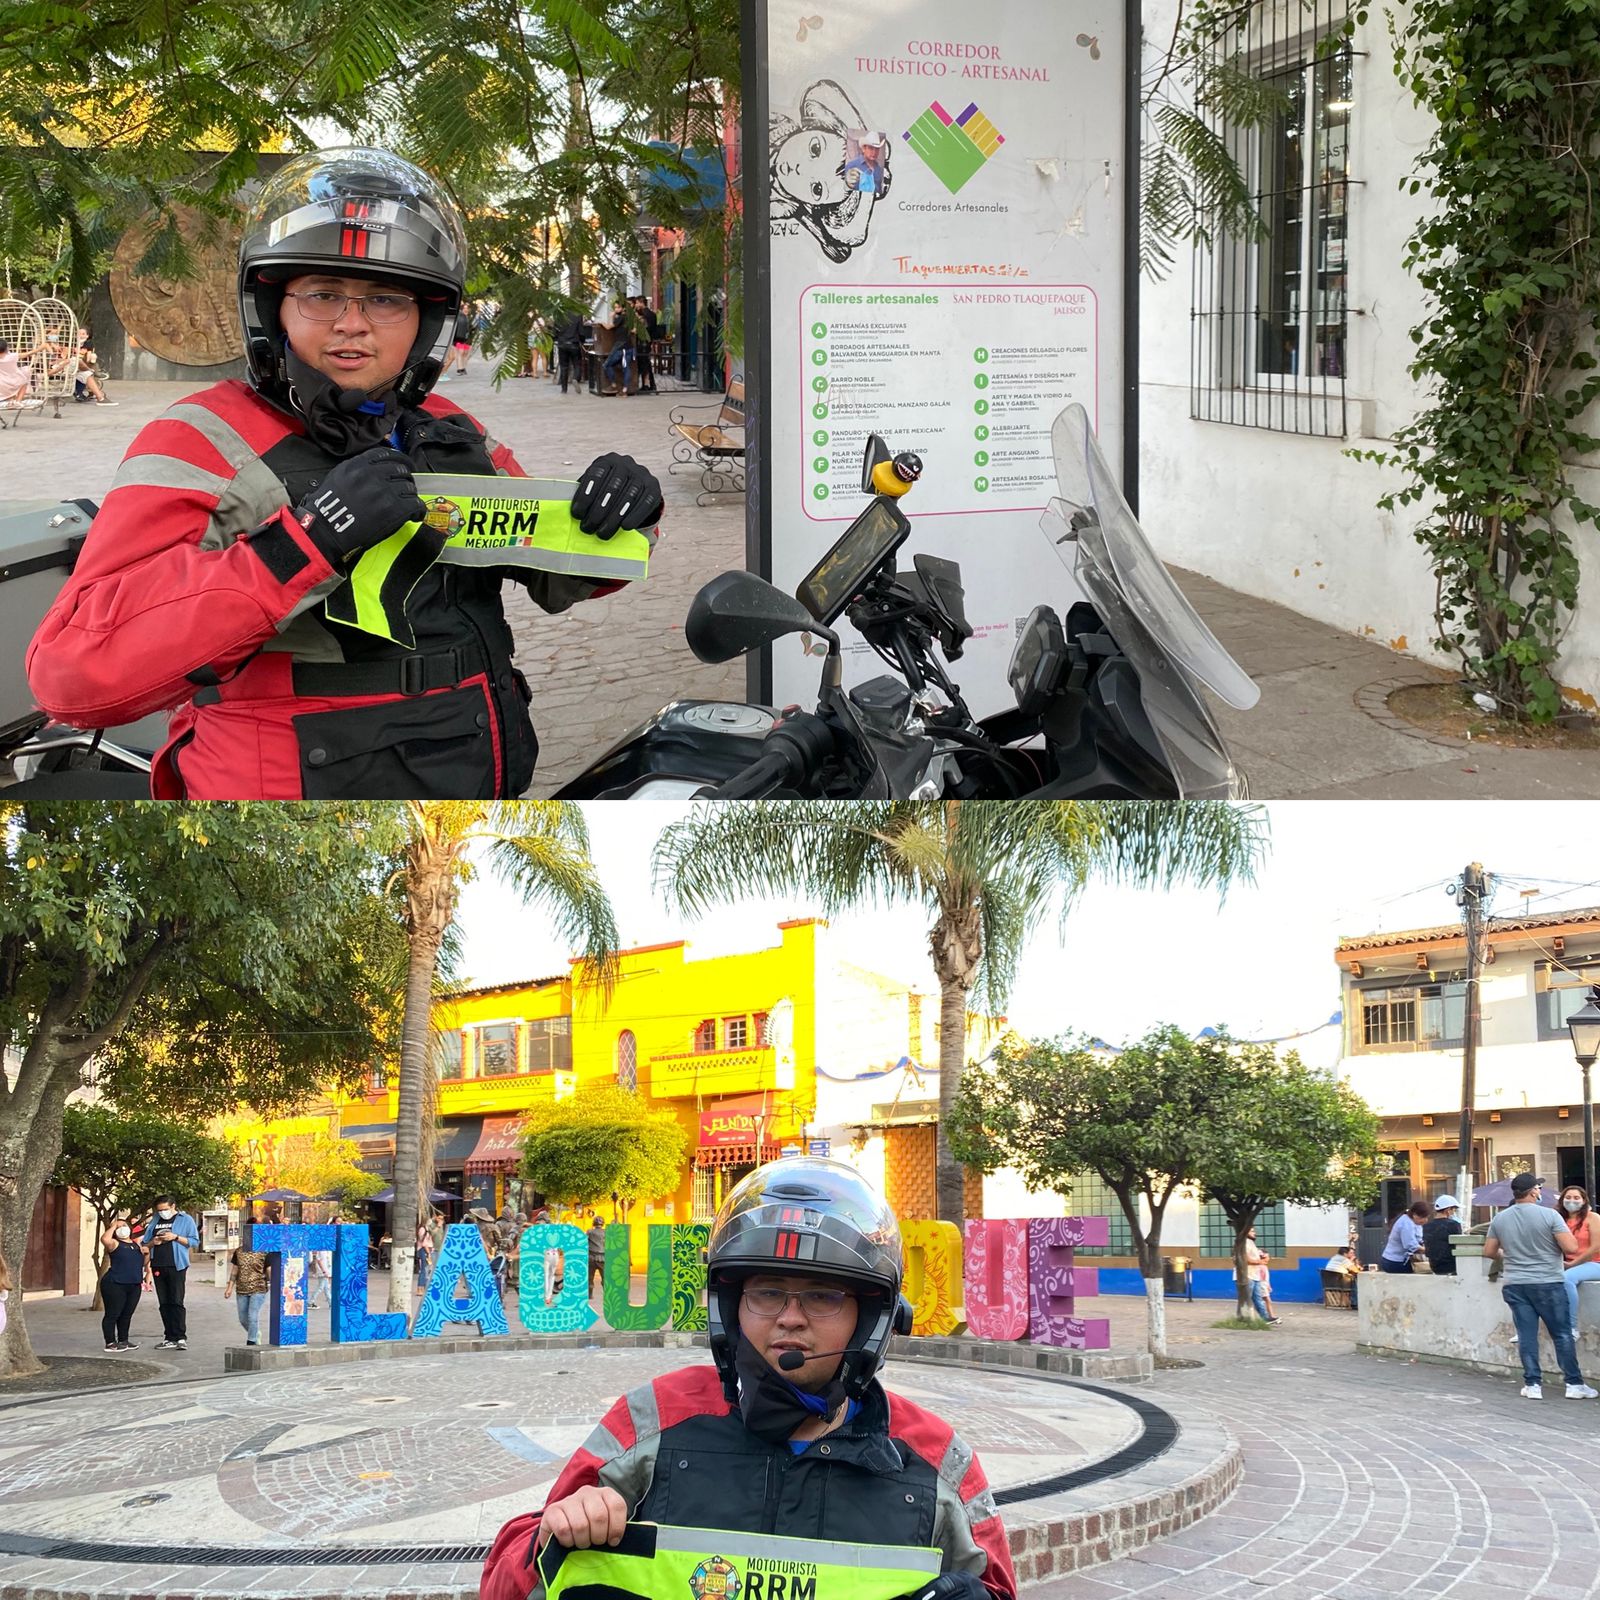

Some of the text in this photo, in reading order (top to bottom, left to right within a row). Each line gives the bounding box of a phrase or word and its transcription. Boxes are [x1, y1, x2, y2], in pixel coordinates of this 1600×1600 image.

[907, 40, 1001, 60] CORREDOR
[855, 56, 947, 77] TURÍSTICO
[961, 65, 1050, 82] ARTESANAL
[898, 201, 1009, 213] Corredores Artesanales
[812, 293, 939, 304] Talleres artesanales
[953, 294, 1086, 305] SAN PEDRO TLAQUEPAQUE
[1054, 307, 1086, 315] JALISCO
[815, 326, 823, 335] A
[816, 353, 823, 362] B
[978, 351, 985, 359] H
[471, 497, 540, 512] MOTOTURISTA
[467, 511, 539, 535] RRM
[465, 537, 506, 548] MÉXICO
[252, 1217, 1108, 1349] TLAQUEQUE
[747, 1557, 817, 1576] MOTOTURISTA
[744, 1572, 816, 1600] RRM
